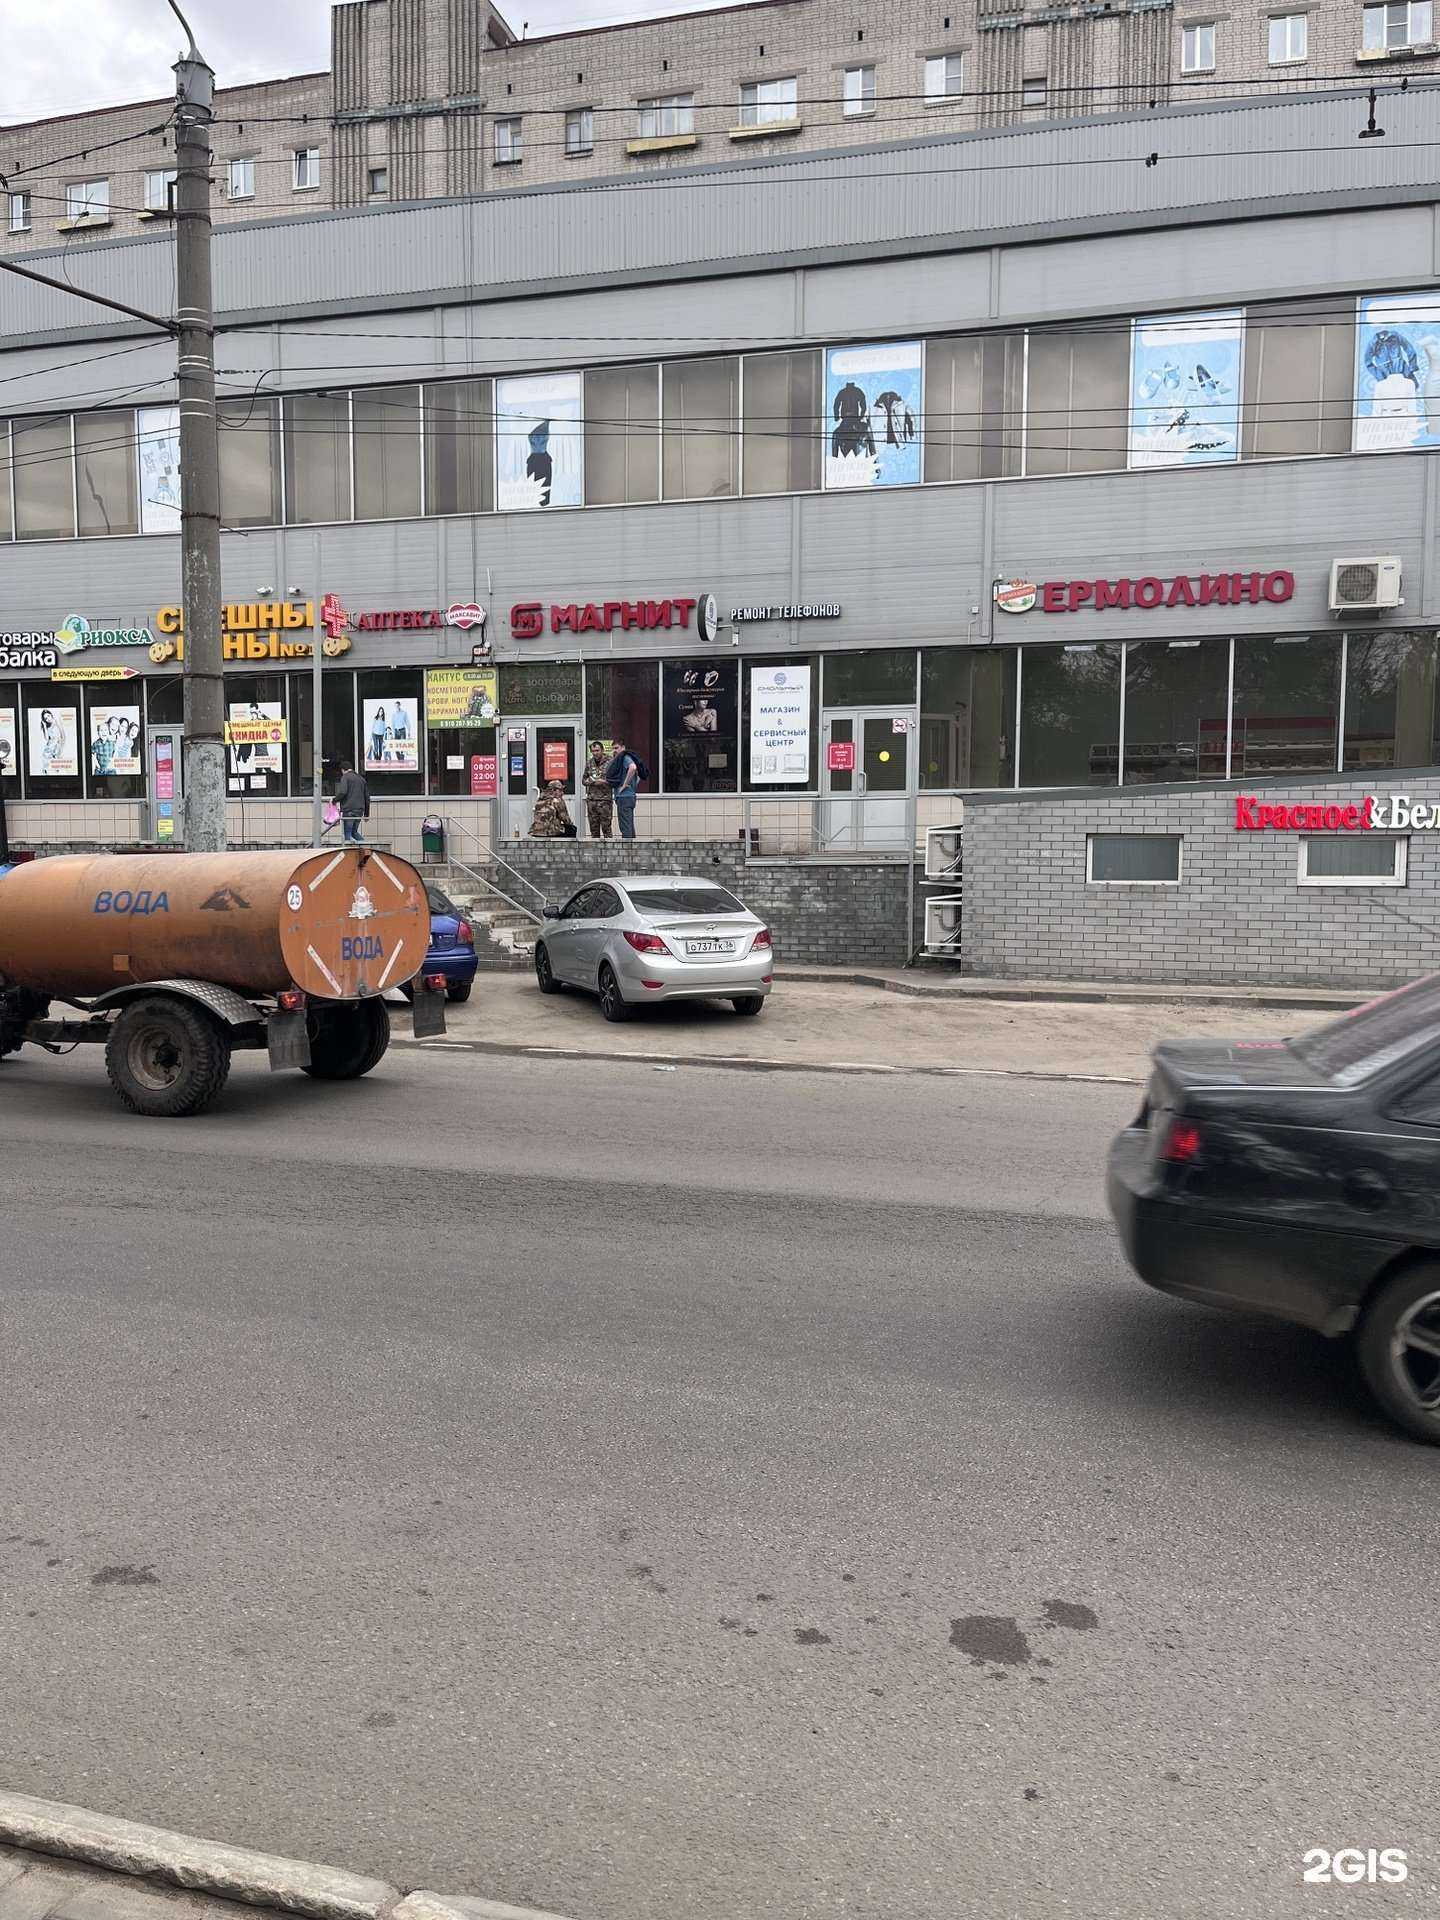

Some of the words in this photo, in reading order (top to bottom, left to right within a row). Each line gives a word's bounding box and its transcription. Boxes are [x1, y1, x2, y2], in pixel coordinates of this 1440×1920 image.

[1043, 570, 1294, 612] ЕРМОЛИНО
[359, 609, 443, 630] АПТЕКА
[551, 599, 696, 633] МАГНИТ
[731, 607, 772, 620] РЕМОНТ
[778, 603, 841, 618] ТЕЛЕФОНОВ
[80, 629, 154, 646] РИОКСА
[59, 669, 99, 679] следующую
[101, 668, 121, 678] дверь
[760, 705, 801, 715] МАГАЗИН
[753, 728, 807, 738] СЕРВИСНЫЙ
[765, 739, 795, 748] ЦЕНТР
[93, 890, 170, 913] ВОДА
[289, 889, 301, 906] 25
[341, 935, 384, 961] ВОДА
